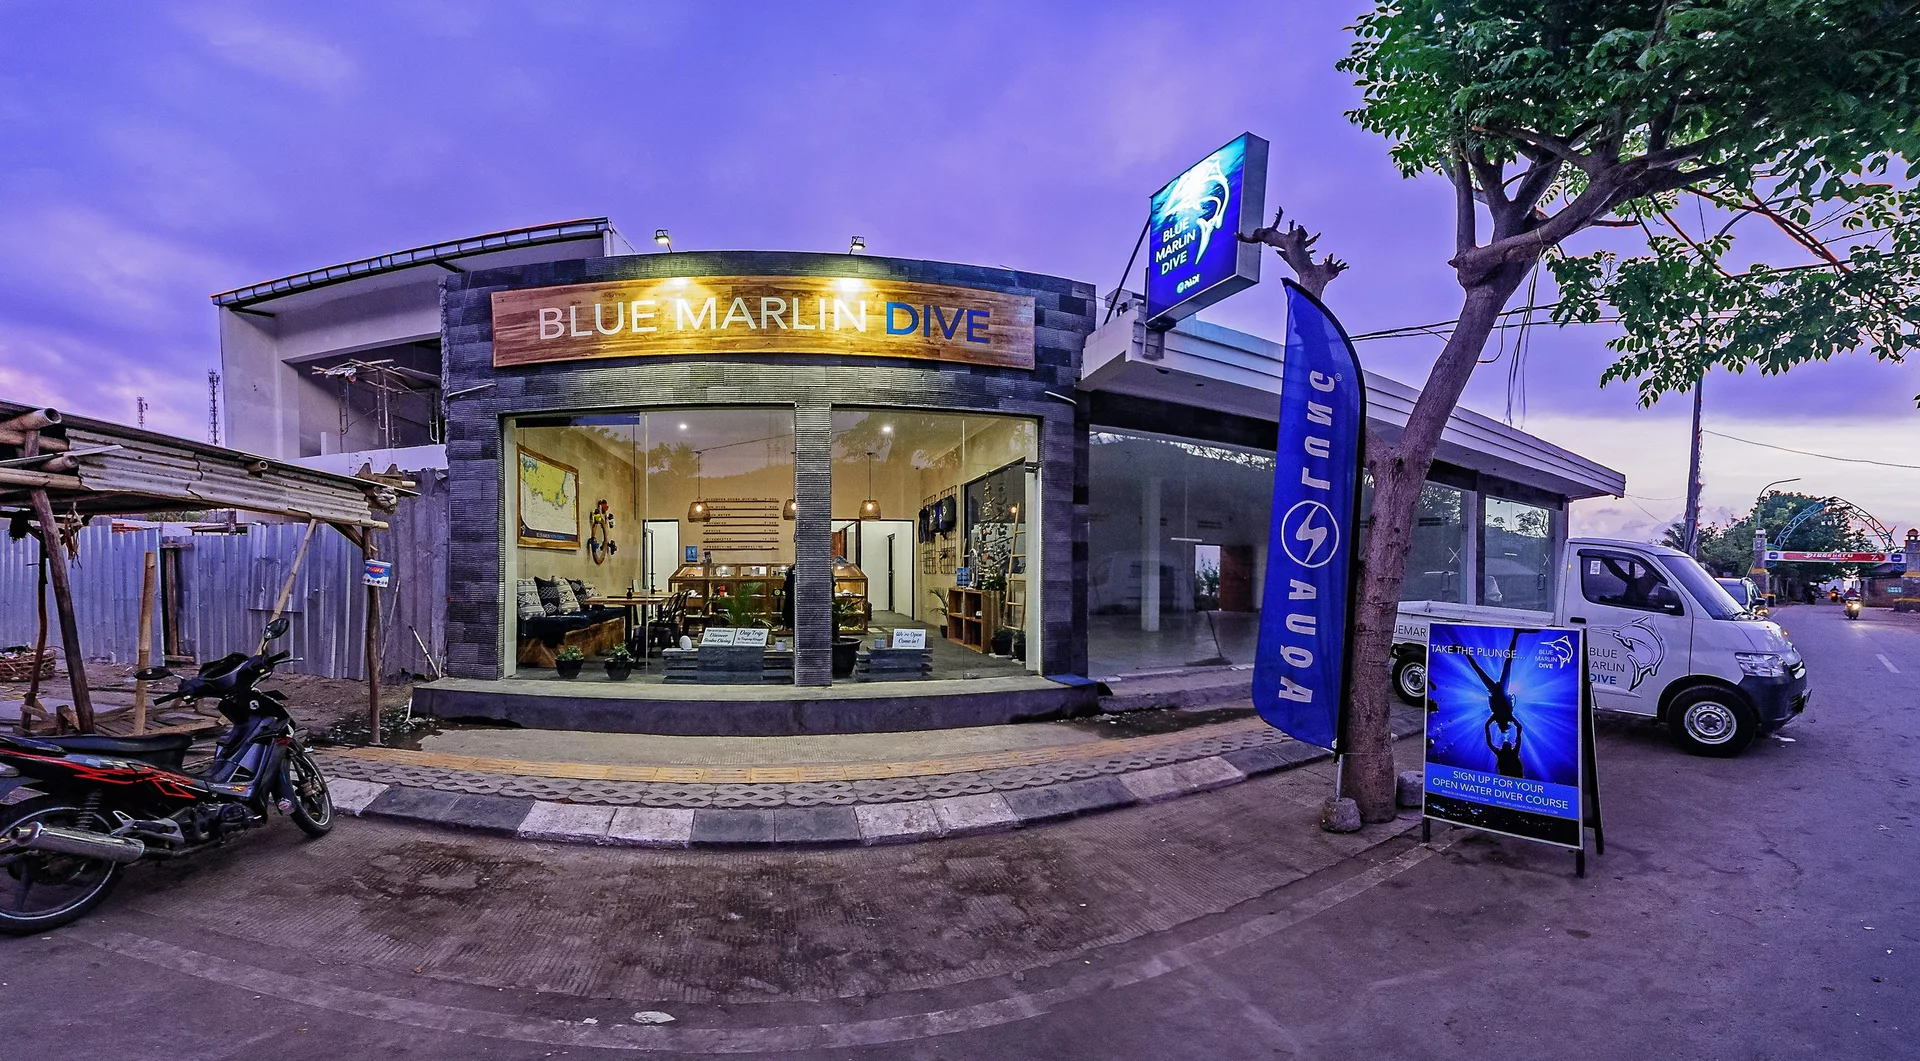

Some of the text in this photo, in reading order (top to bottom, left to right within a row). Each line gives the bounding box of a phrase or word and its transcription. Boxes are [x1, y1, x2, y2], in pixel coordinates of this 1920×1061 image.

[1162, 217, 1189, 243] BLUE
[1155, 229, 1196, 263] MARLIN
[1161, 250, 1187, 275] DIVE
[538, 297, 990, 343] BLUE MARLIN DIVE
[1430, 643, 1526, 660] TAKE THE PLUNGE...
[1534, 655, 1558, 663] MARLIN
[1589, 647, 1618, 659] BLUE
[1588, 660, 1625, 673] ARLIN
[1432, 777, 1569, 810] OPEN WATER DIVER COURSE
[1453, 770, 1544, 794] SIGN UP FOR YOUR
